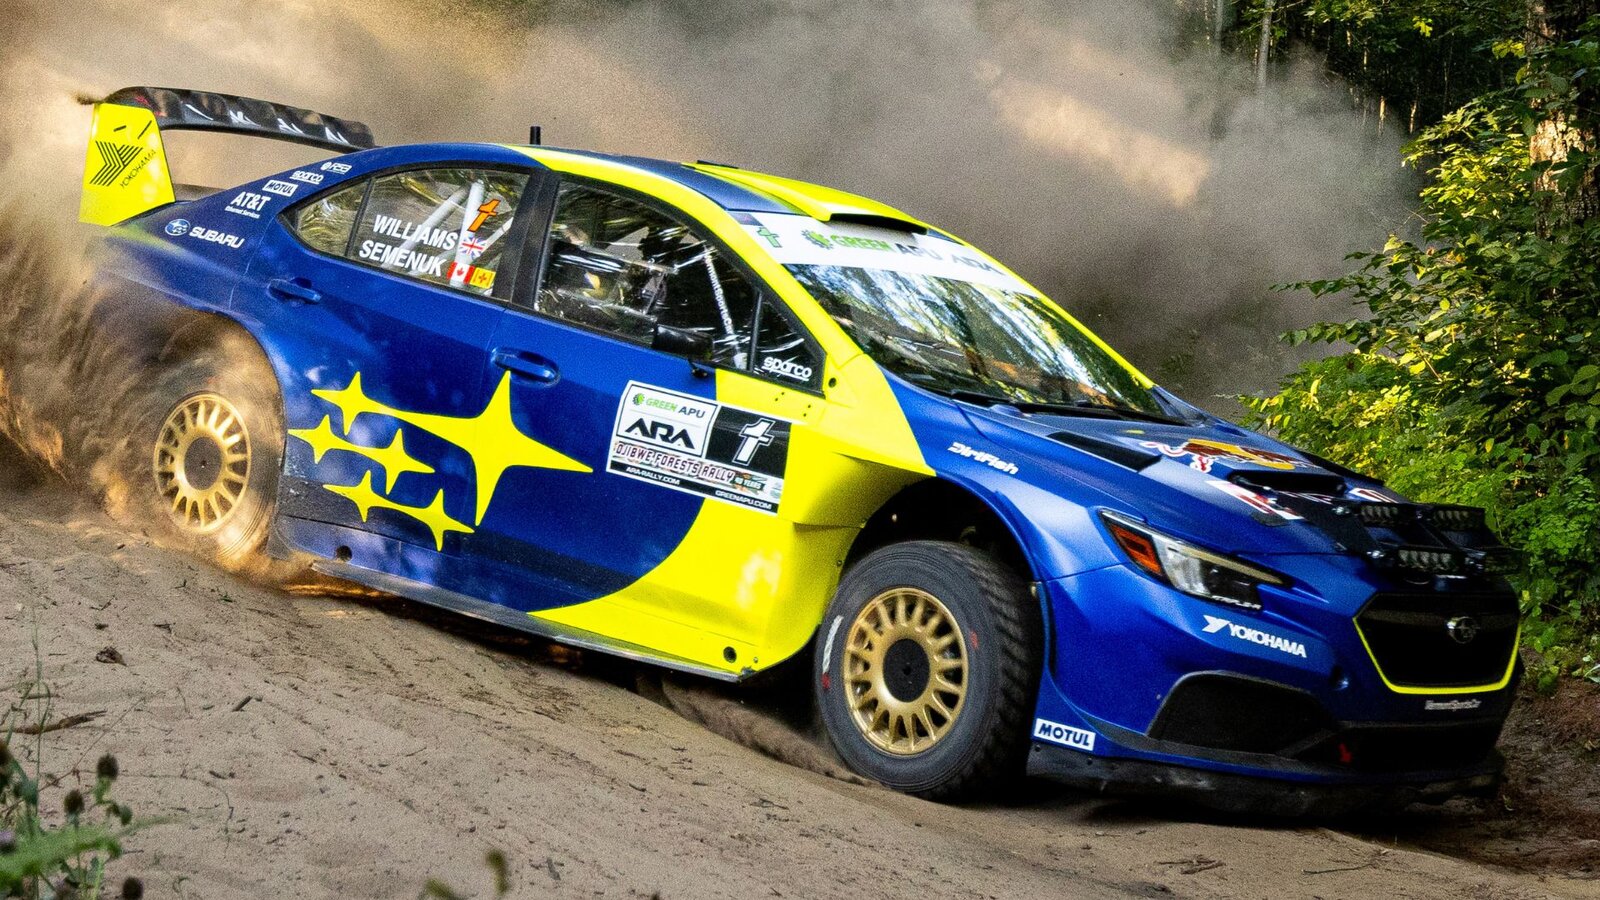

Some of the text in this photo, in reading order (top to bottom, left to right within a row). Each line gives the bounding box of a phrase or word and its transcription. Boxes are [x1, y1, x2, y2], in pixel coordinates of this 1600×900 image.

[265, 181, 294, 194] MOTUL
[230, 191, 271, 211] AT&T
[189, 226, 245, 249] SUBARU
[373, 214, 458, 251] WILLIAMS
[830, 234, 896, 252] GREEN
[359, 240, 447, 277] SEMENUK
[761, 356, 813, 381] sparco
[645, 397, 706, 419] GREEN APU
[625, 417, 696, 450] ARA
[614, 442, 654, 463] OJIBWE
[654, 453, 701, 475] FORESTS
[700, 465, 736, 483] RALLY
[626, 466, 681, 486] ARA-RALLY.COM
[1229, 623, 1307, 659] YOKOHAMA
[1038, 722, 1091, 747] MOTUL
